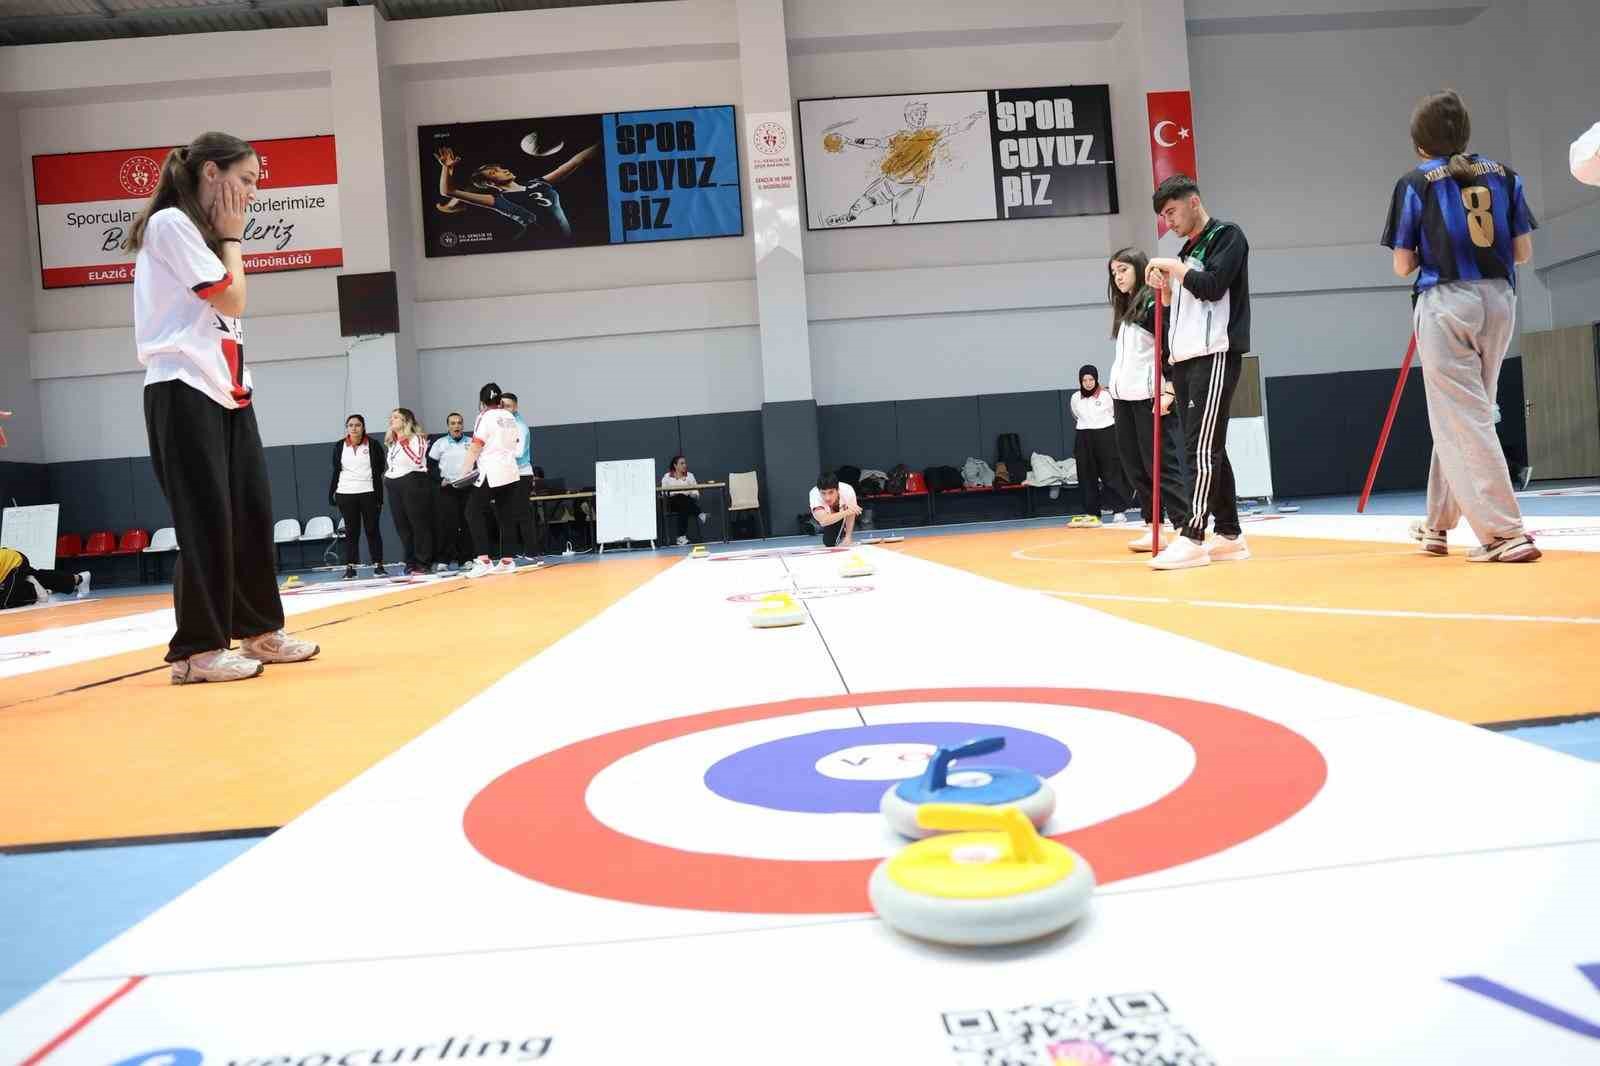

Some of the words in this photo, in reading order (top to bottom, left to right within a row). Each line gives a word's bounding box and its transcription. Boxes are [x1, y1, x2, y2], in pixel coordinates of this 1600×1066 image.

[996, 98, 1074, 132] SPOR
[616, 120, 696, 155] SPOR
[1000, 135, 1095, 169] CUYUZ
[619, 157, 717, 193] CUYUZ
[66, 209, 137, 228] Sporcular
[244, 195, 326, 213] nörlerimize
[1461, 186, 1494, 247] 8
[243, 217, 295, 251] leriz
